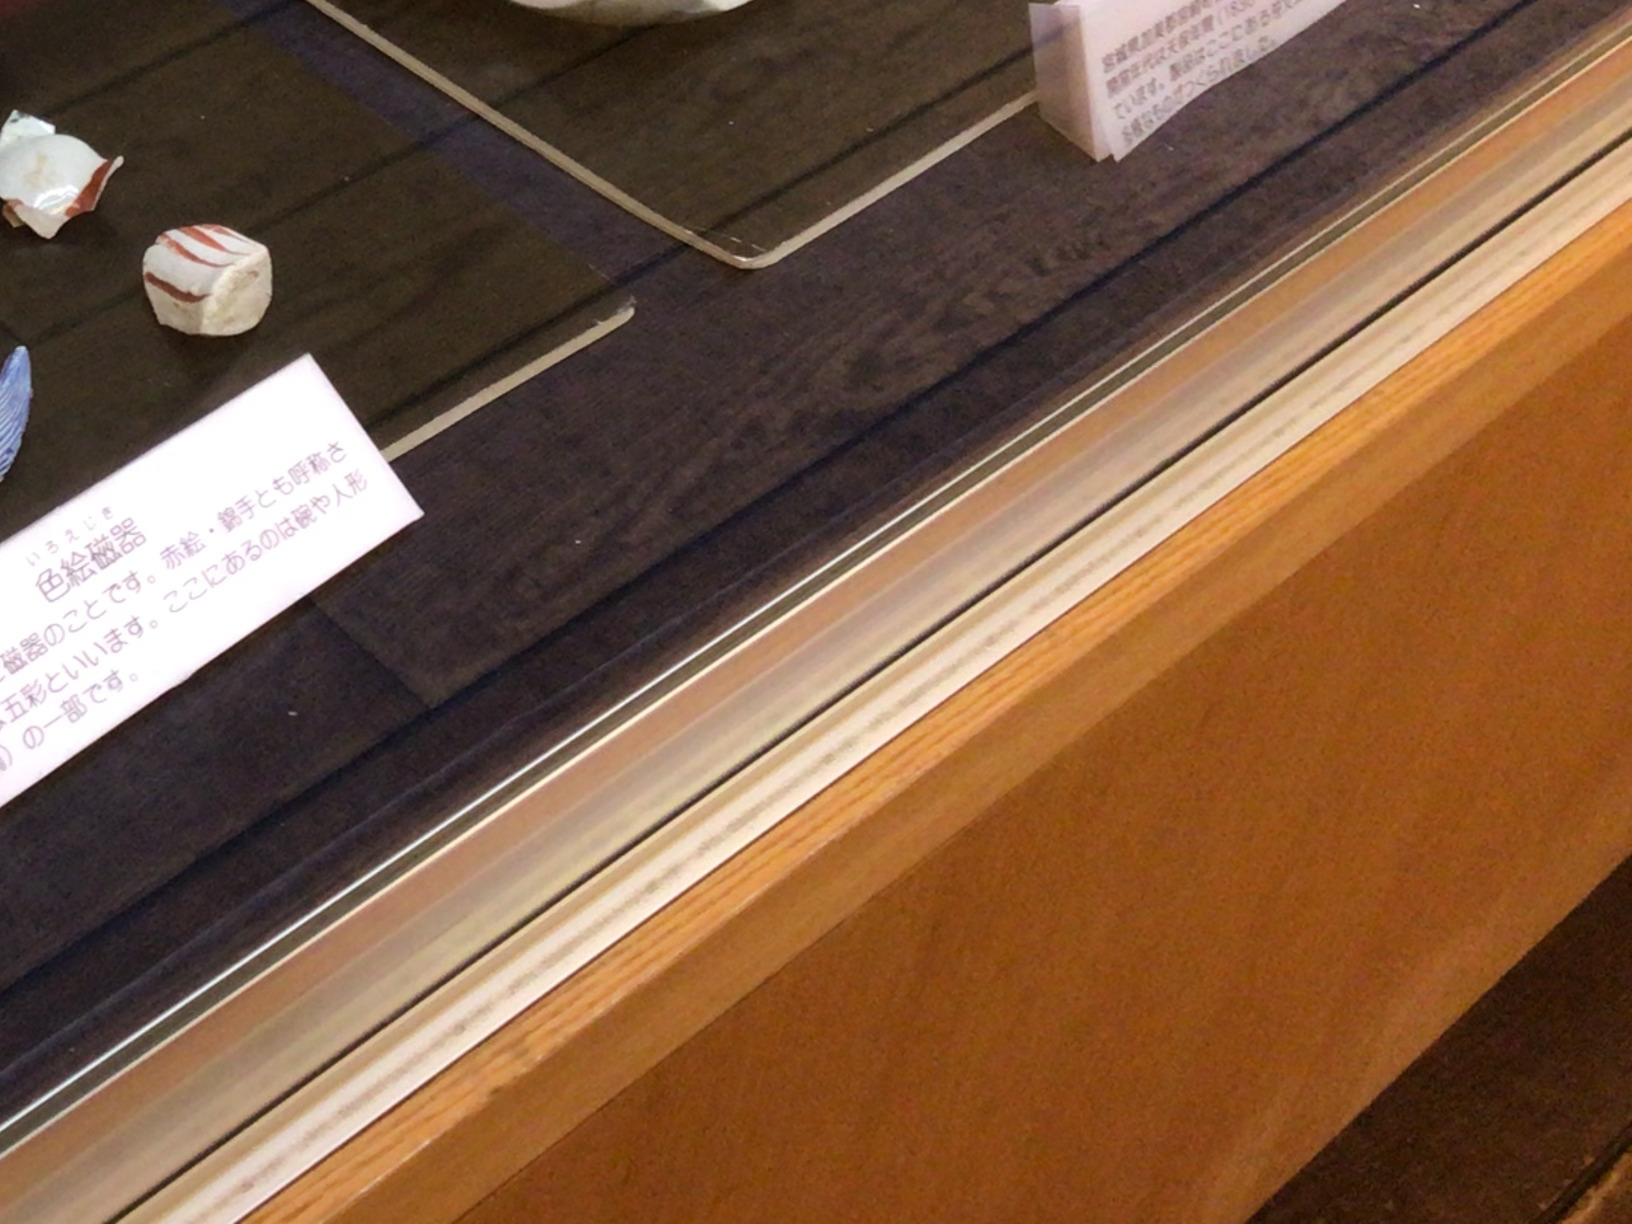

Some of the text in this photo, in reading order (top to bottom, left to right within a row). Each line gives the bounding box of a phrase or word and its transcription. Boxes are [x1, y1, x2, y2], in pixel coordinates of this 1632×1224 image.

[25, 506, 114, 567] いろえじき
[35, 517, 147, 603] 色絵磁器
